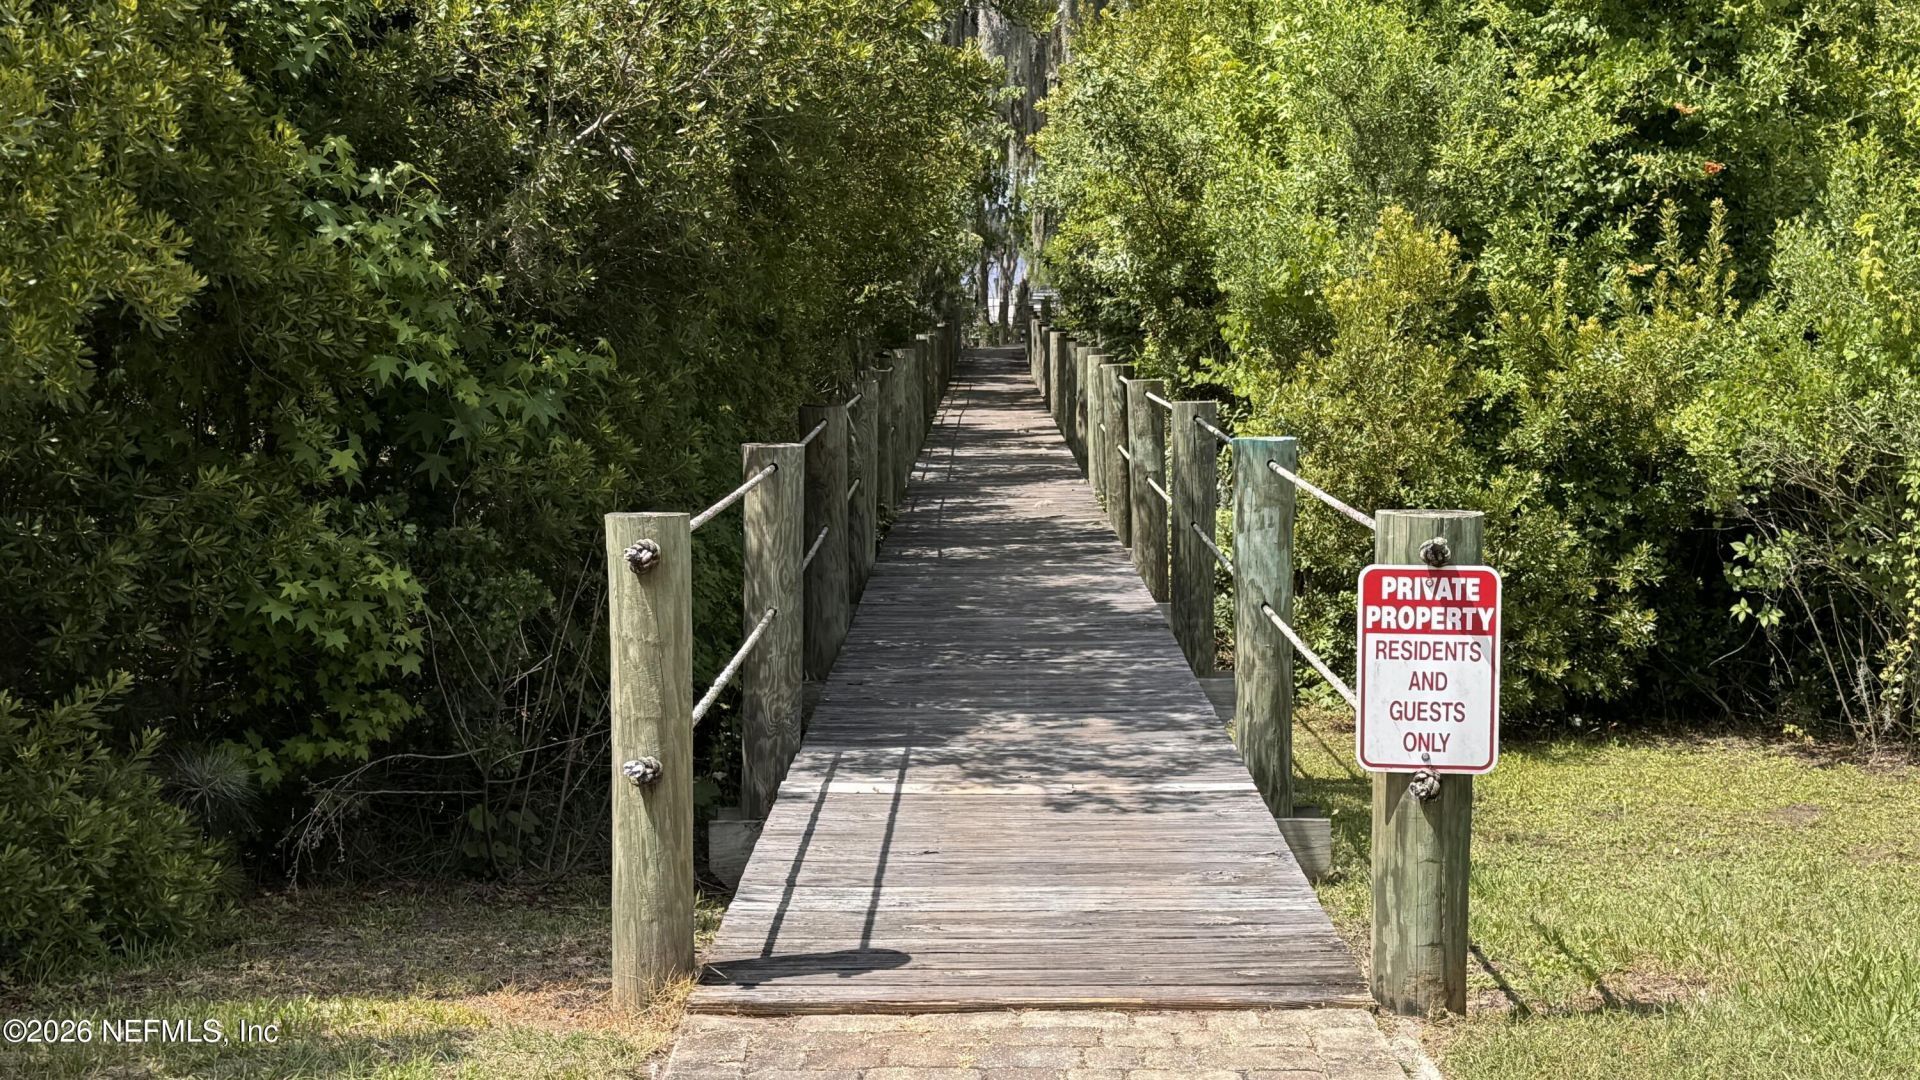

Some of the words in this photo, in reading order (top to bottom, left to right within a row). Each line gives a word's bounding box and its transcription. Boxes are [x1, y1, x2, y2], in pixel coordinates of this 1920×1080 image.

[1381, 576, 1481, 601] PRIVATE
[1366, 605, 1495, 631] PROPERTY
[1375, 640, 1482, 662] RESIDENTS
[1408, 671, 1448, 691] AND
[1389, 700, 1466, 722] GUESTS
[1403, 732, 1451, 753] ONLY
